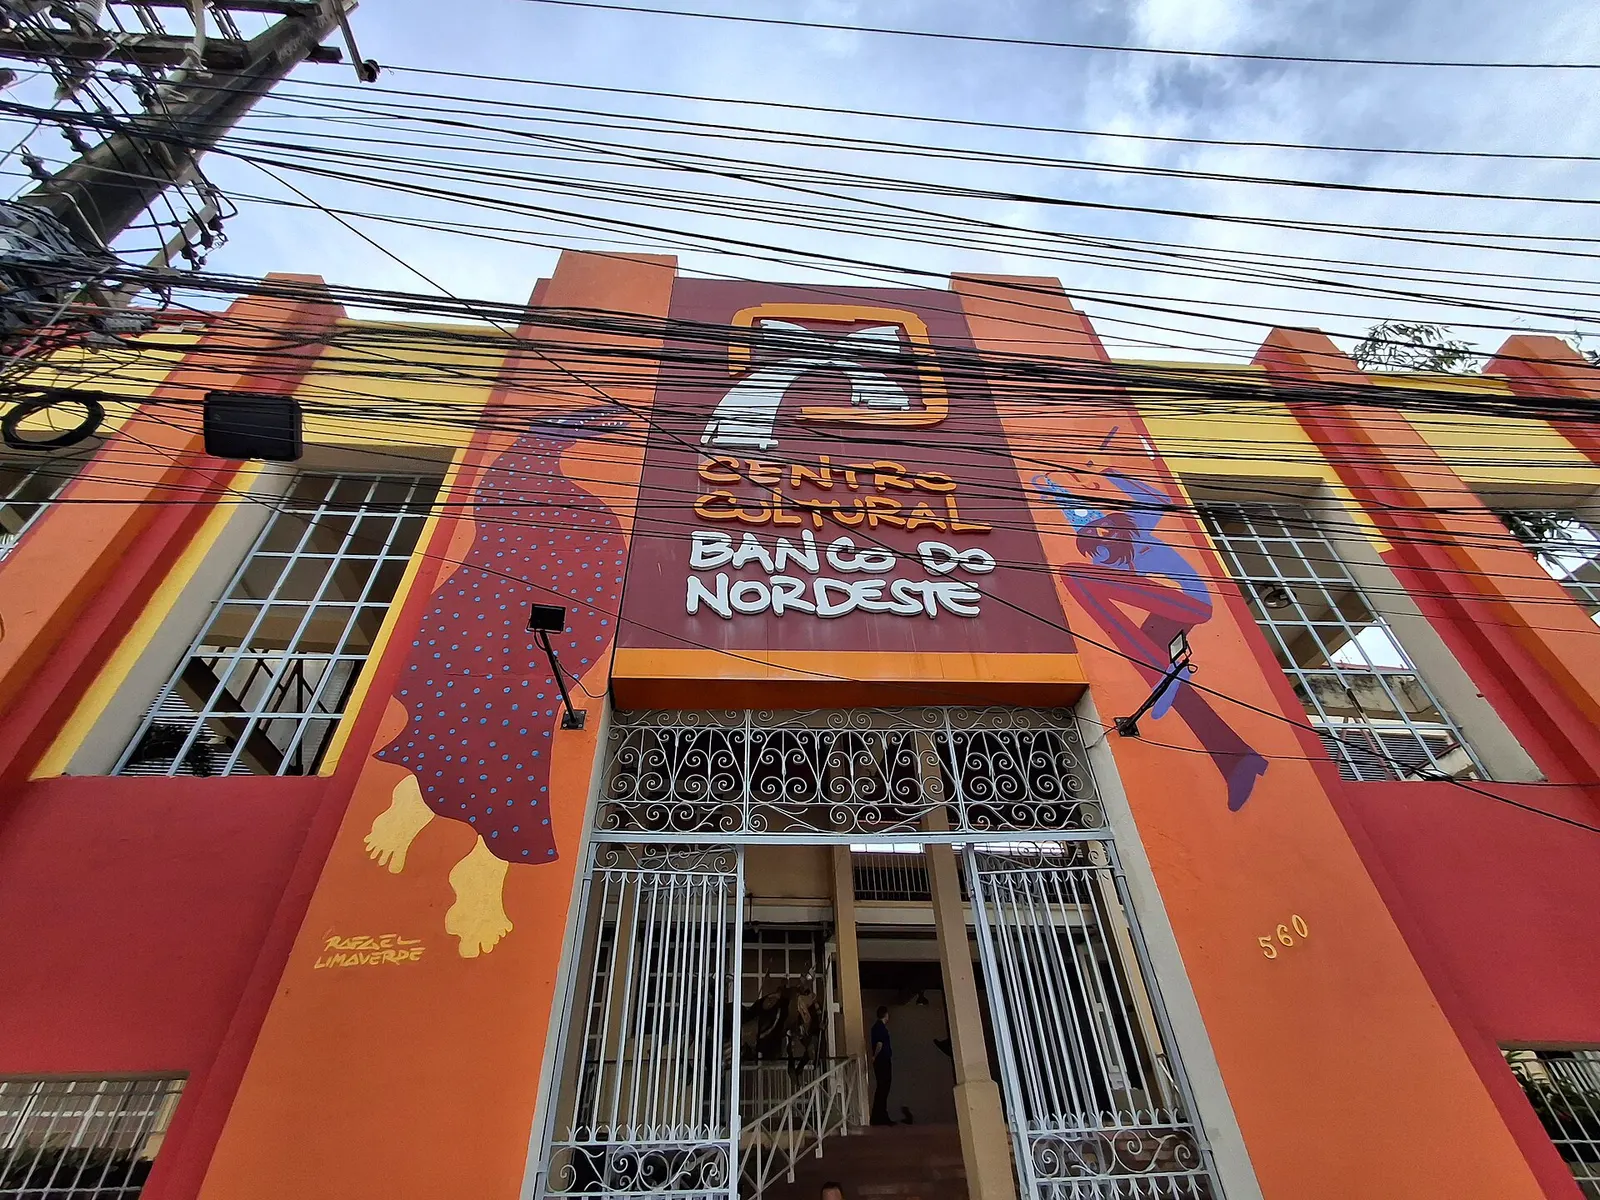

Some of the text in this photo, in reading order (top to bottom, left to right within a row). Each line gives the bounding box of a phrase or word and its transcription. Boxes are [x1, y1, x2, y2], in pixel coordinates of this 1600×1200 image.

[697, 455, 958, 492] CENTRO
[693, 487, 994, 533] CULTURAL
[689, 528, 997, 576] BANCO DO
[686, 572, 982, 620] NORDESTE
[314, 947, 426, 969] LIMAVERDE
[323, 933, 421, 952] RAFAEL
[1258, 914, 1309, 959] 560
